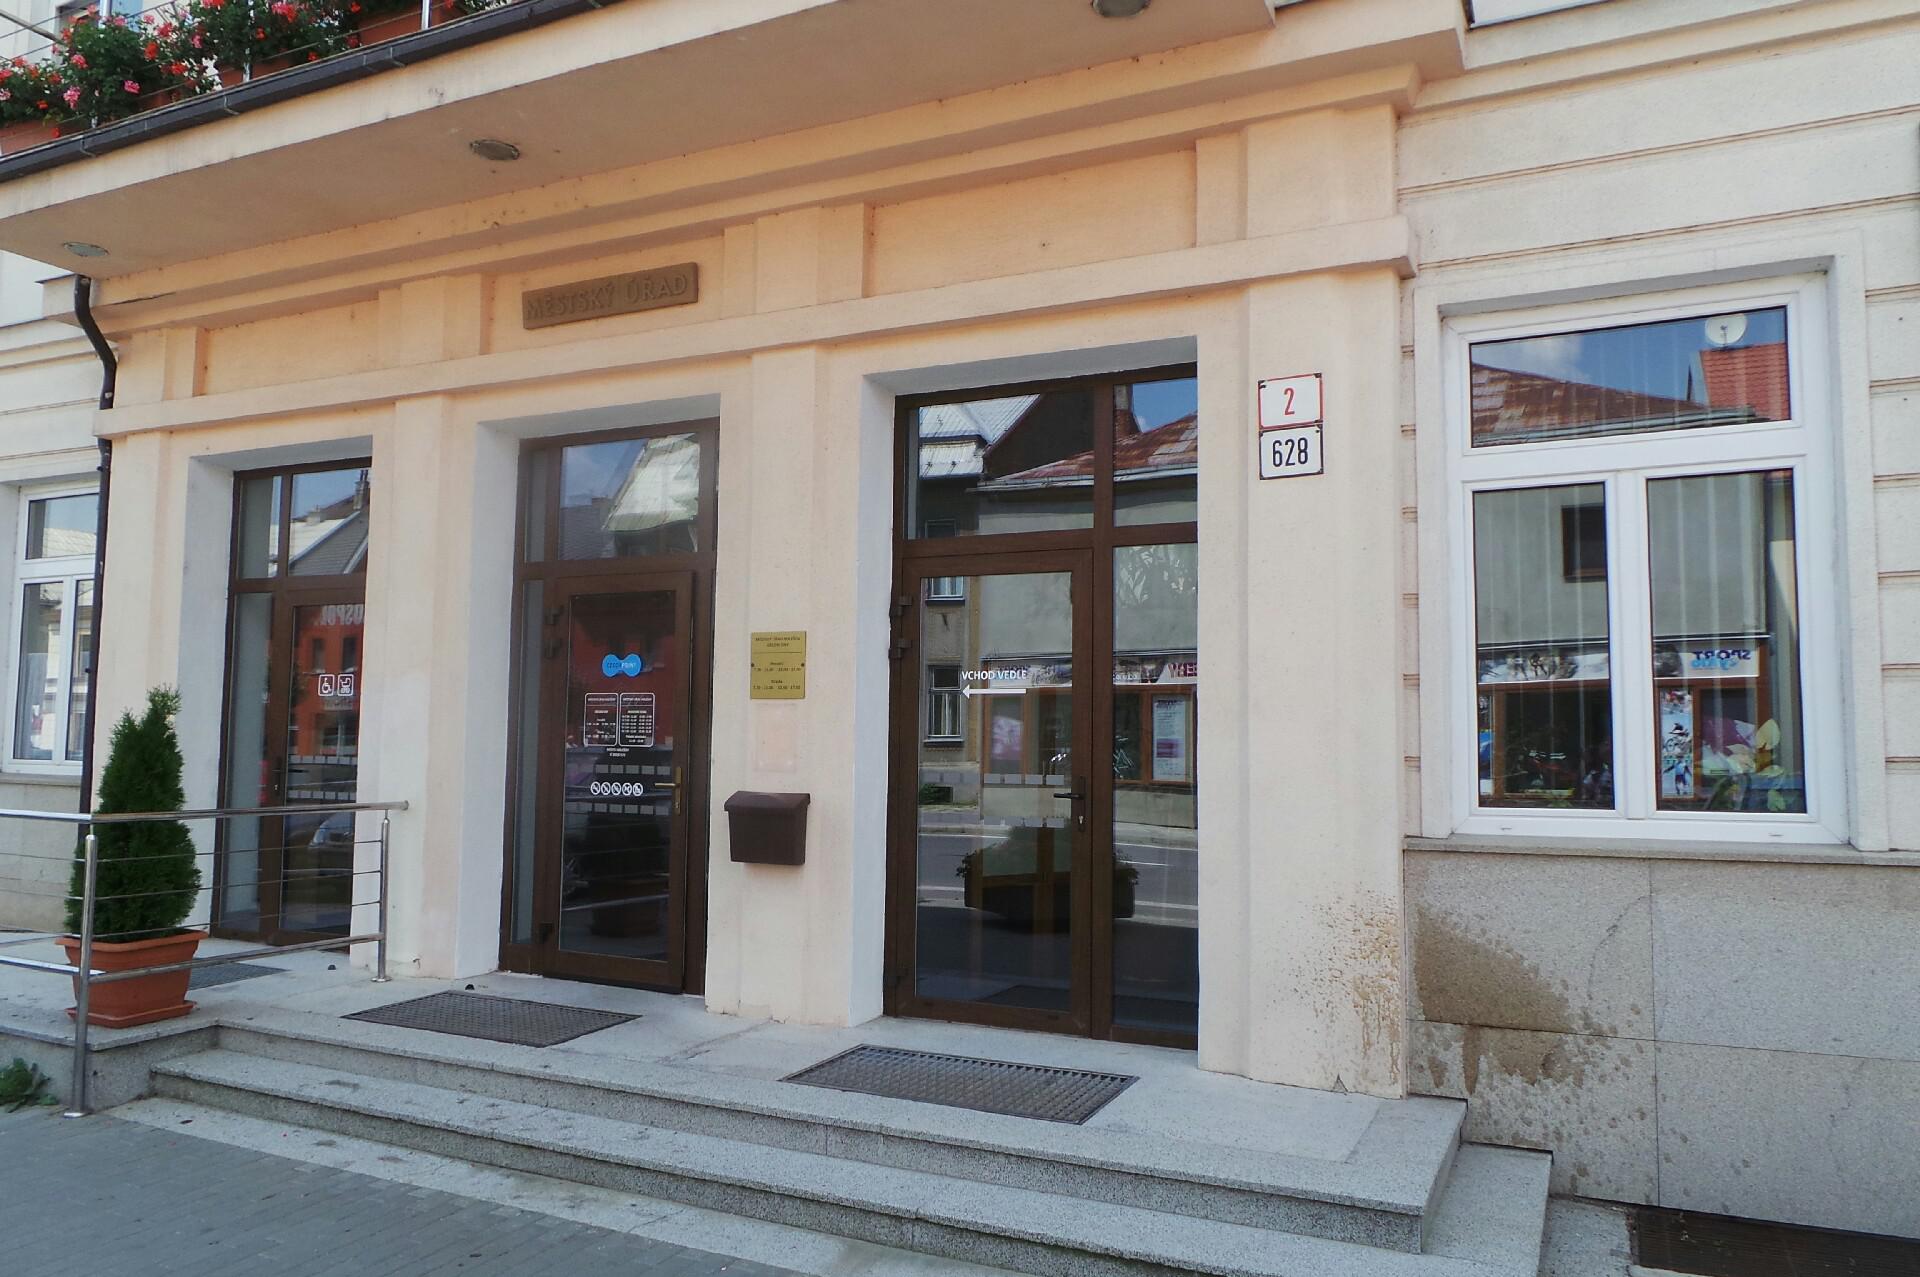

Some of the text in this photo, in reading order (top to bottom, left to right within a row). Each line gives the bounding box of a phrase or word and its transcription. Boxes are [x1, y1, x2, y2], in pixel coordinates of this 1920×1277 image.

[624, 273, 689, 304] ÚŘAD
[1284, 387, 1296, 416] 2
[1272, 437, 1309, 468] 628
[961, 670, 995, 681] VCHOD
